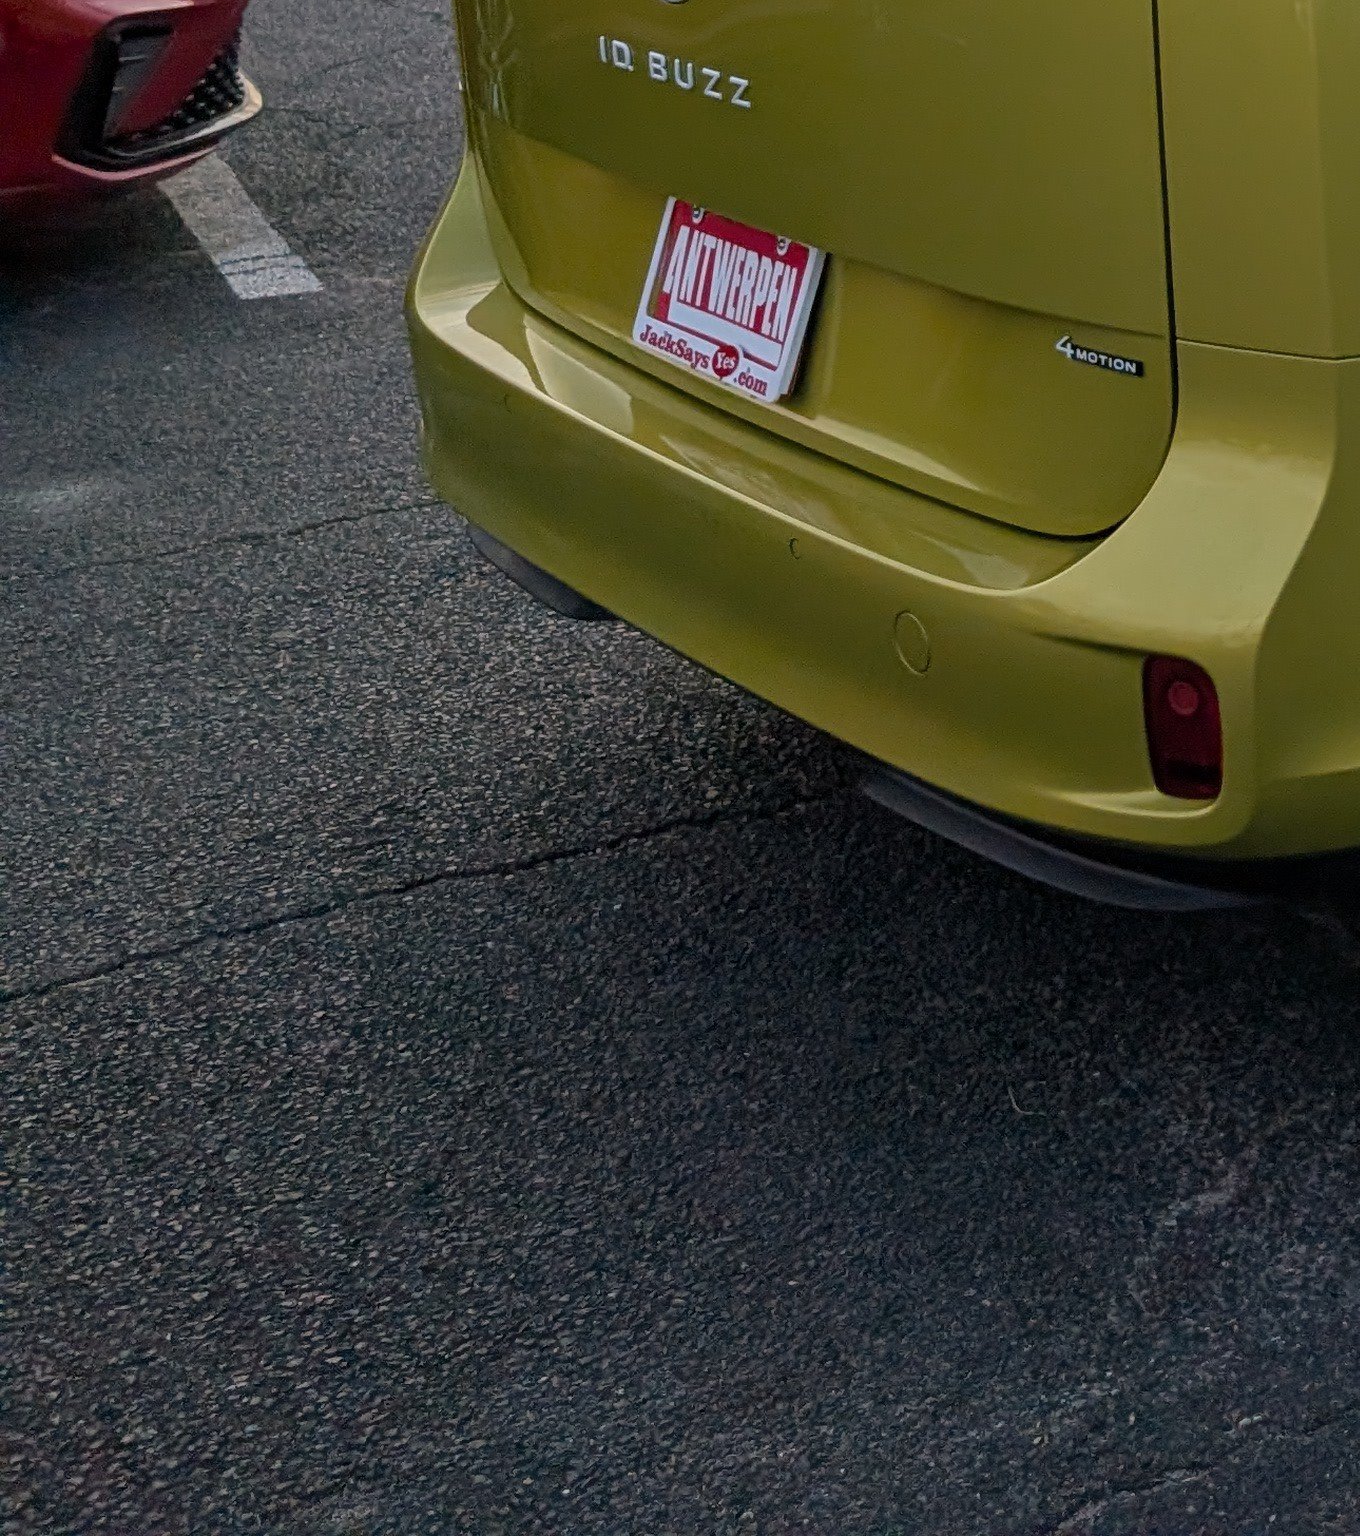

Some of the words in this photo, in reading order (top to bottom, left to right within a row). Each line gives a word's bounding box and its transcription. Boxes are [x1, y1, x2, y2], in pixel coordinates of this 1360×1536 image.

[649, 50, 751, 109] BUZZ
[662, 224, 798, 342] ANTWERPEN
[1055, 334, 1137, 374] 4MOTION
